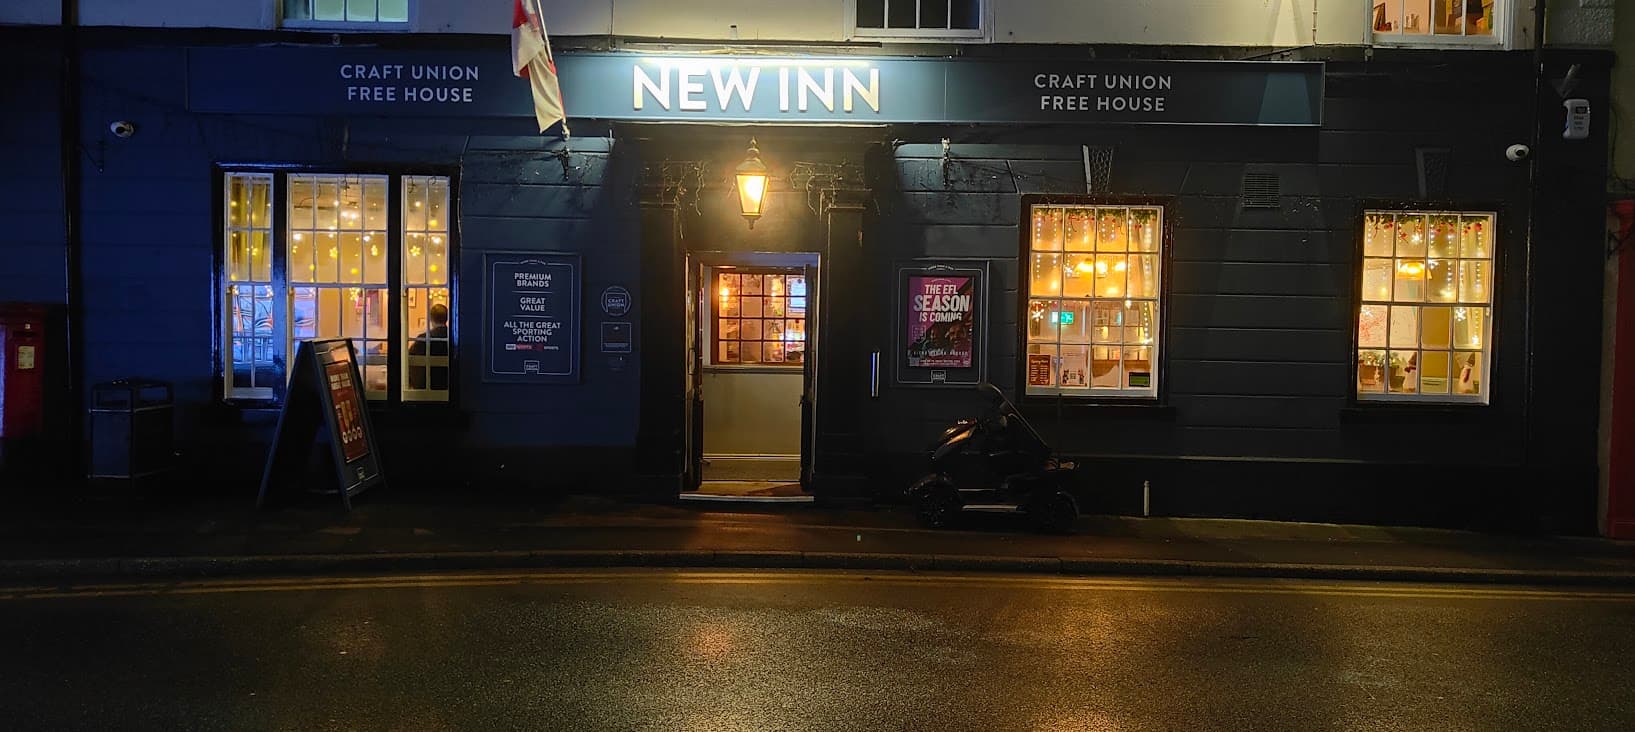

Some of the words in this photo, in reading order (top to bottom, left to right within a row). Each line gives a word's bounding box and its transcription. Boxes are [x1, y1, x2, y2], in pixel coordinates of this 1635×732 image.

[340, 64, 404, 79] CRAFT
[411, 65, 479, 80] UNION
[1034, 73, 1097, 89] CRAFT
[1104, 75, 1172, 90] UNION
[347, 86, 396, 101] FREE
[404, 87, 473, 102] HOUSE
[633, 65, 761, 111] NEW
[779, 67, 880, 113] INN
[1041, 95, 1089, 111] FREE
[1097, 96, 1165, 112] HOUSE
[514, 272, 552, 281] PREMIUM
[516, 280, 549, 288] BRANDS
[925, 284, 942, 295] THE
[943, 284, 959, 295] EFL
[520, 297, 546, 305] GREAT
[913, 294, 971, 312] SEASON
[520, 304, 545, 312] VALUE
[919, 311, 928, 323] IS
[929, 311, 963, 323] COMING
[503, 321, 518, 329] ALL
[518, 321, 535, 329] THE
[535, 321, 561, 329] GREAT
[512, 328, 552, 336] SPORTING
[517, 335, 547, 343] ACTION
